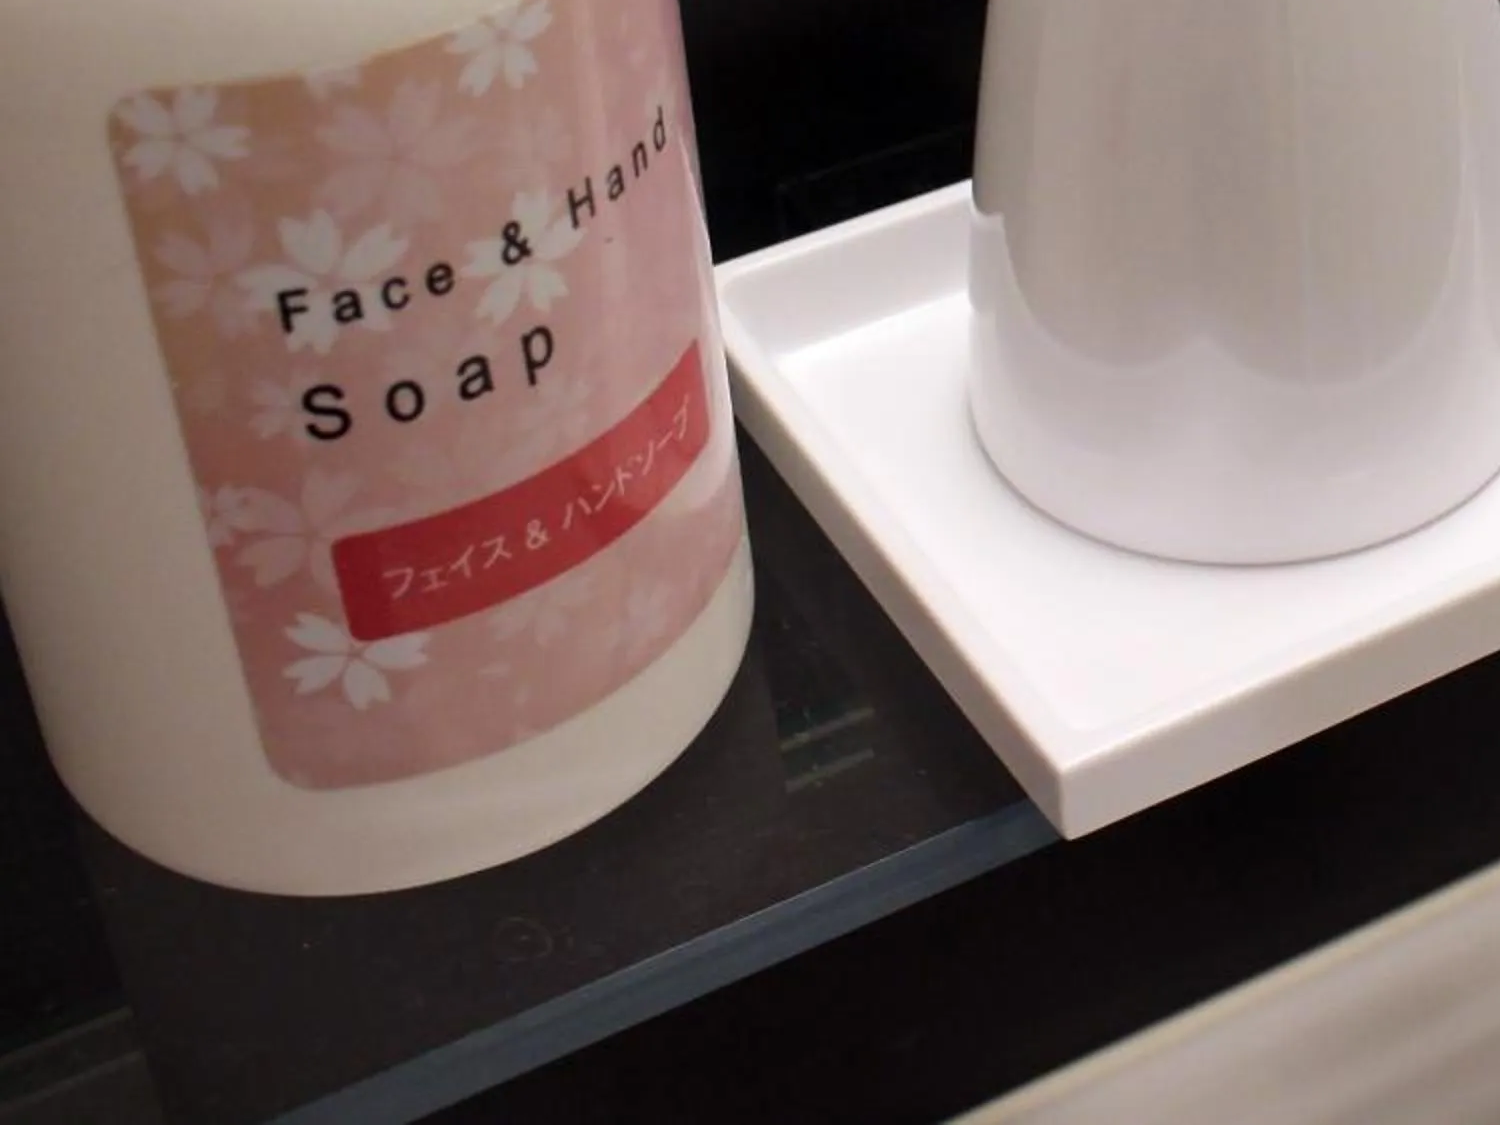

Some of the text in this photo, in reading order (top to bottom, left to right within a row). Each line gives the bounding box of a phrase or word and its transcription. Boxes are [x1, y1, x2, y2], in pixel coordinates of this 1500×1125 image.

[276, 106, 668, 334] Face & Hand
[301, 324, 554, 441] Soap
[382, 536, 513, 600] フェイス
[524, 519, 549, 550] &
